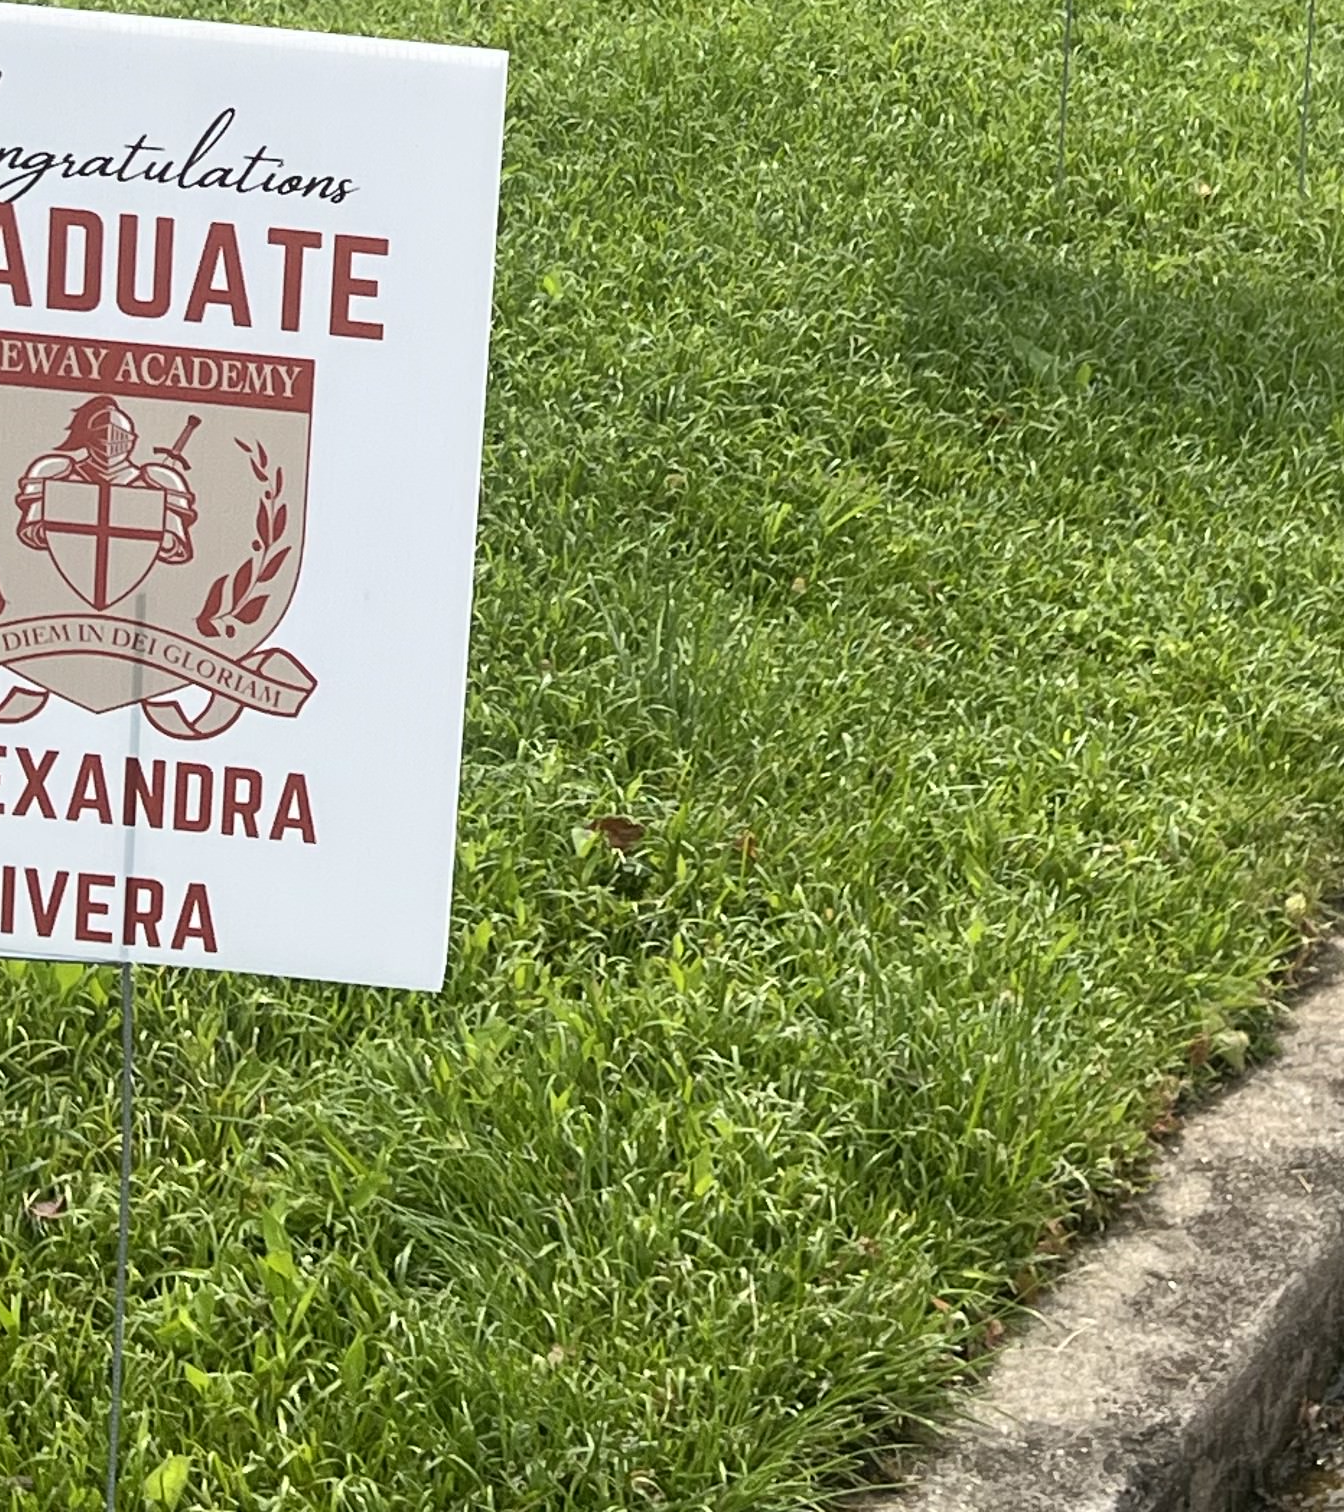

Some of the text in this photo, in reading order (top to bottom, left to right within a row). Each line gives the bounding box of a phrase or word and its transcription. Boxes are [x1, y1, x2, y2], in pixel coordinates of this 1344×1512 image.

[119, 351, 304, 400] ACADEMY
[1, 624, 73, 653] DIEM
[77, 623, 106, 643] IN
[111, 626, 158, 655] DEI
[161, 642, 284, 709] GLORIAM
